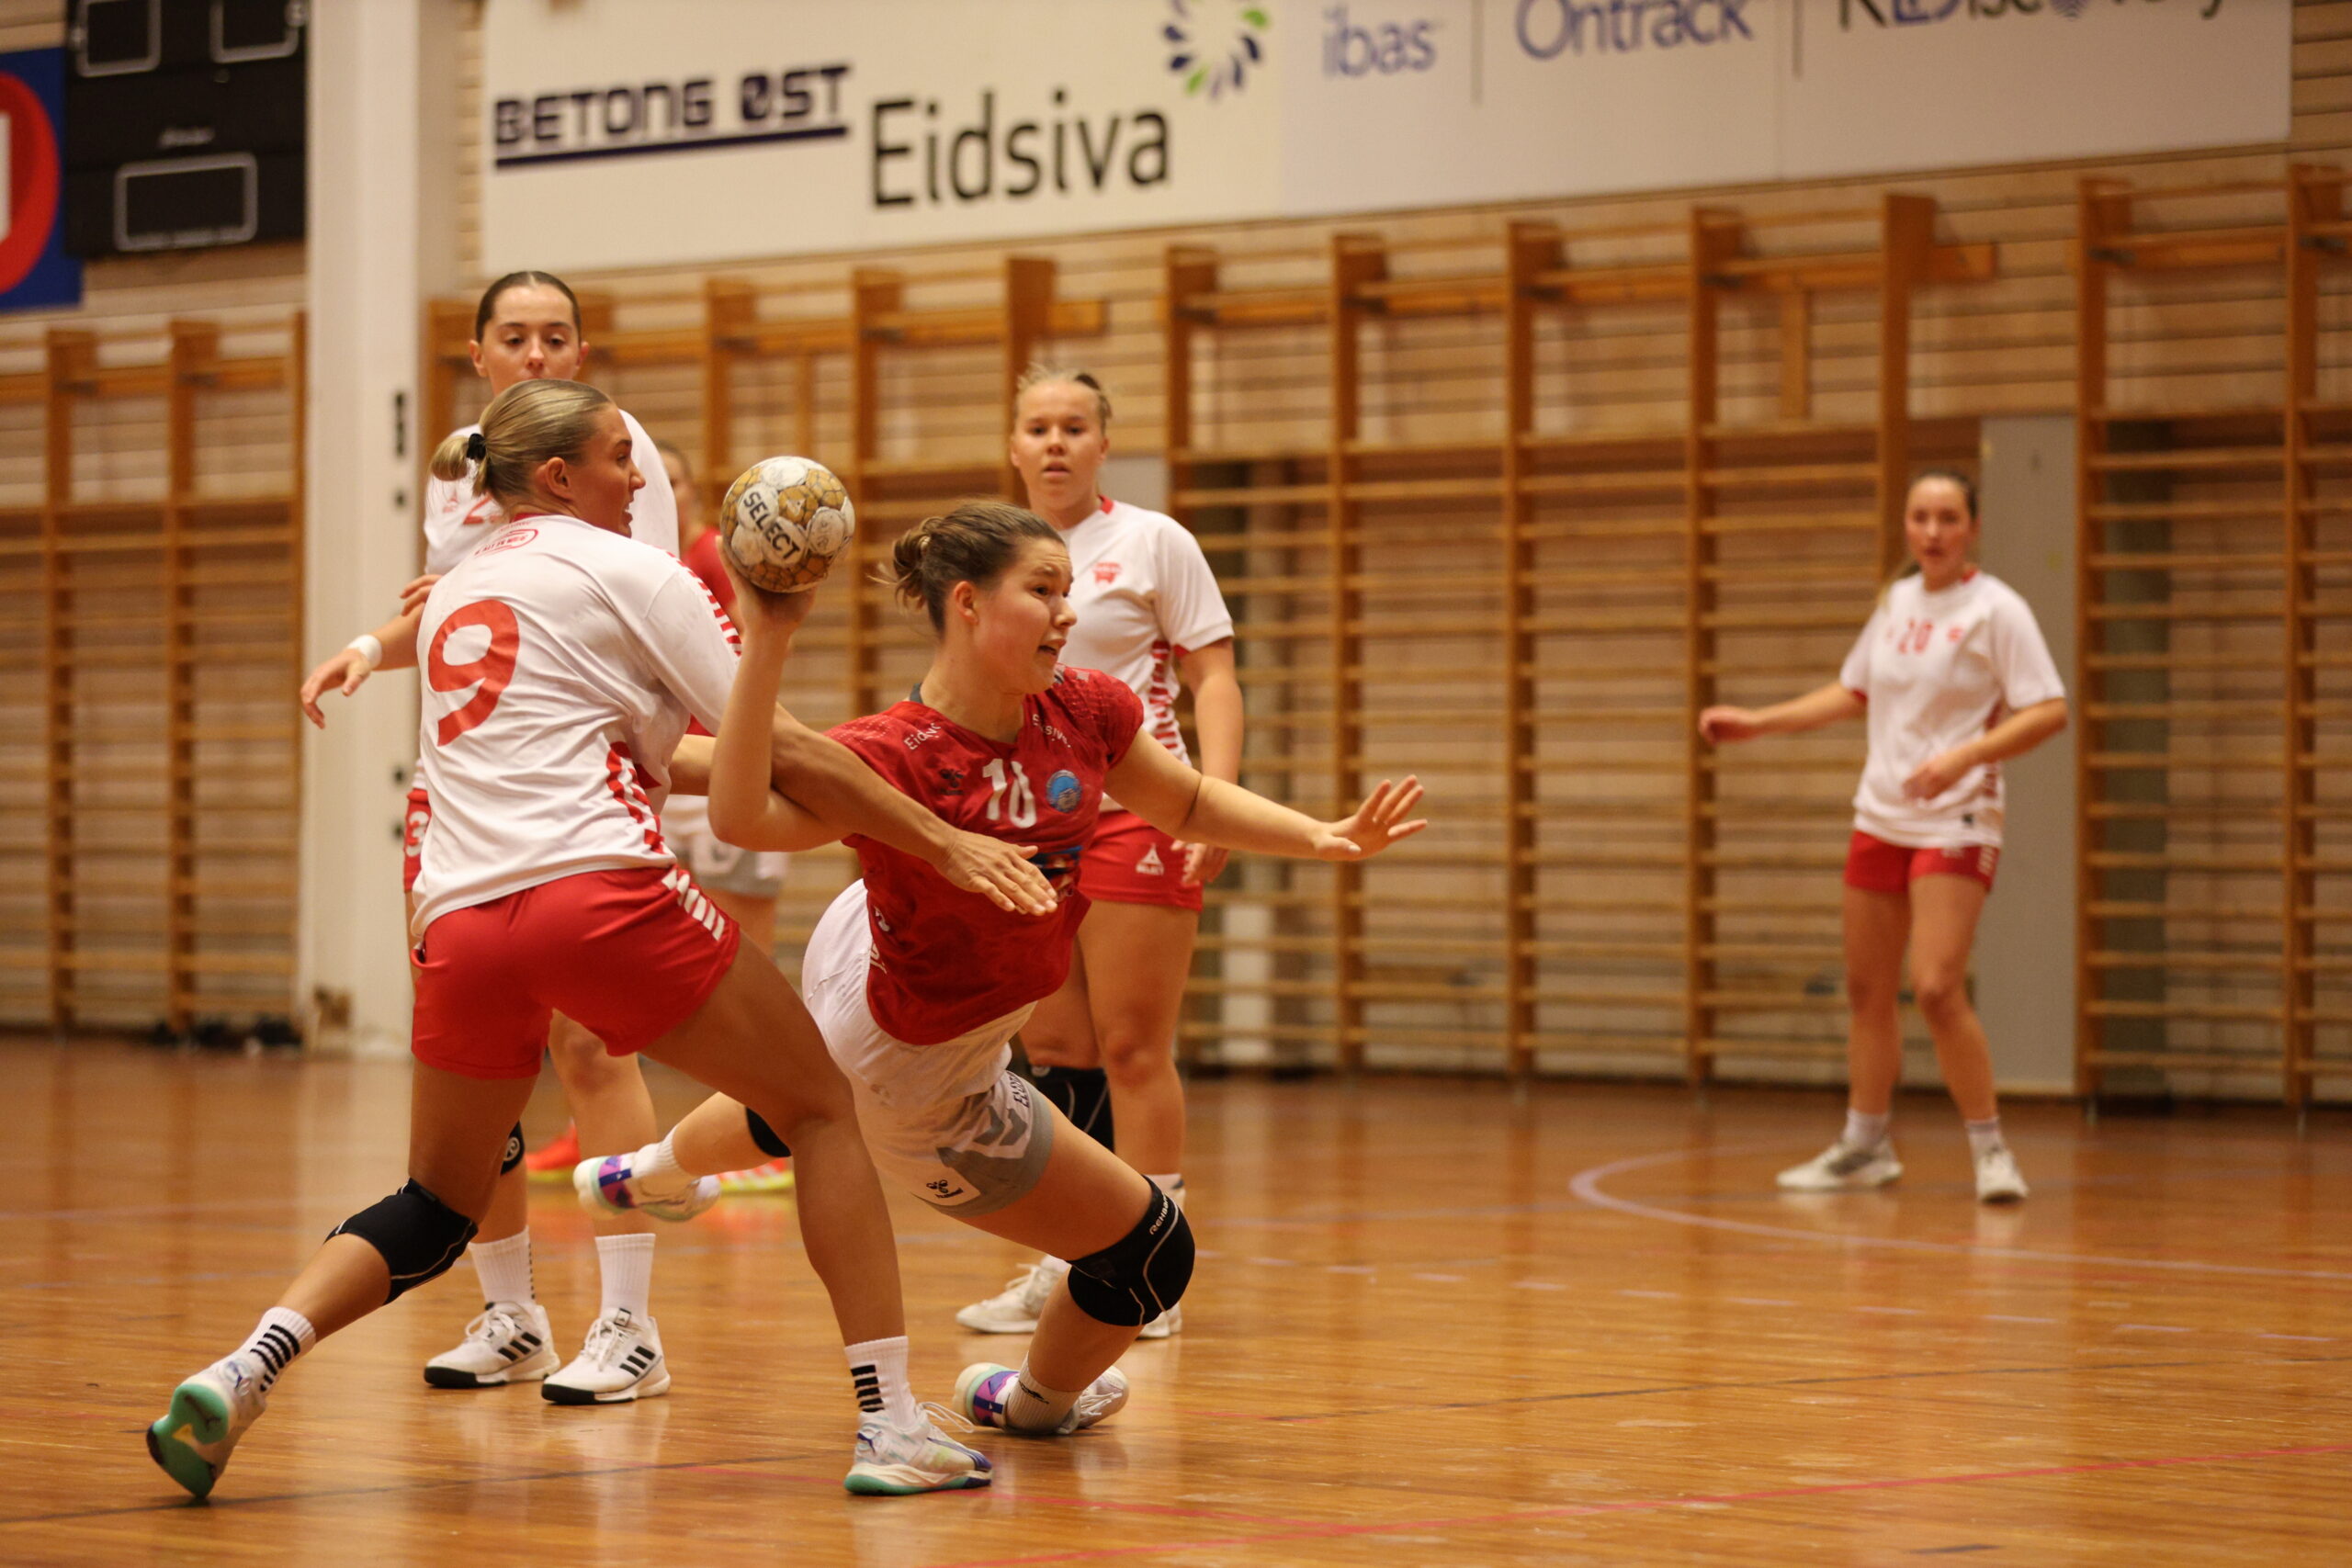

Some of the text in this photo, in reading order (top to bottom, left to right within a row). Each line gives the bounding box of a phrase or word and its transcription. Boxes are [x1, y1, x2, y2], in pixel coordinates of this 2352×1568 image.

[1323, 5, 1436, 77] ibas
[493, 65, 851, 145] BETONG ØST
[873, 87, 1170, 208] Eidsiva
[743, 491, 800, 559] SELECT
[428, 599, 520, 747] 9
